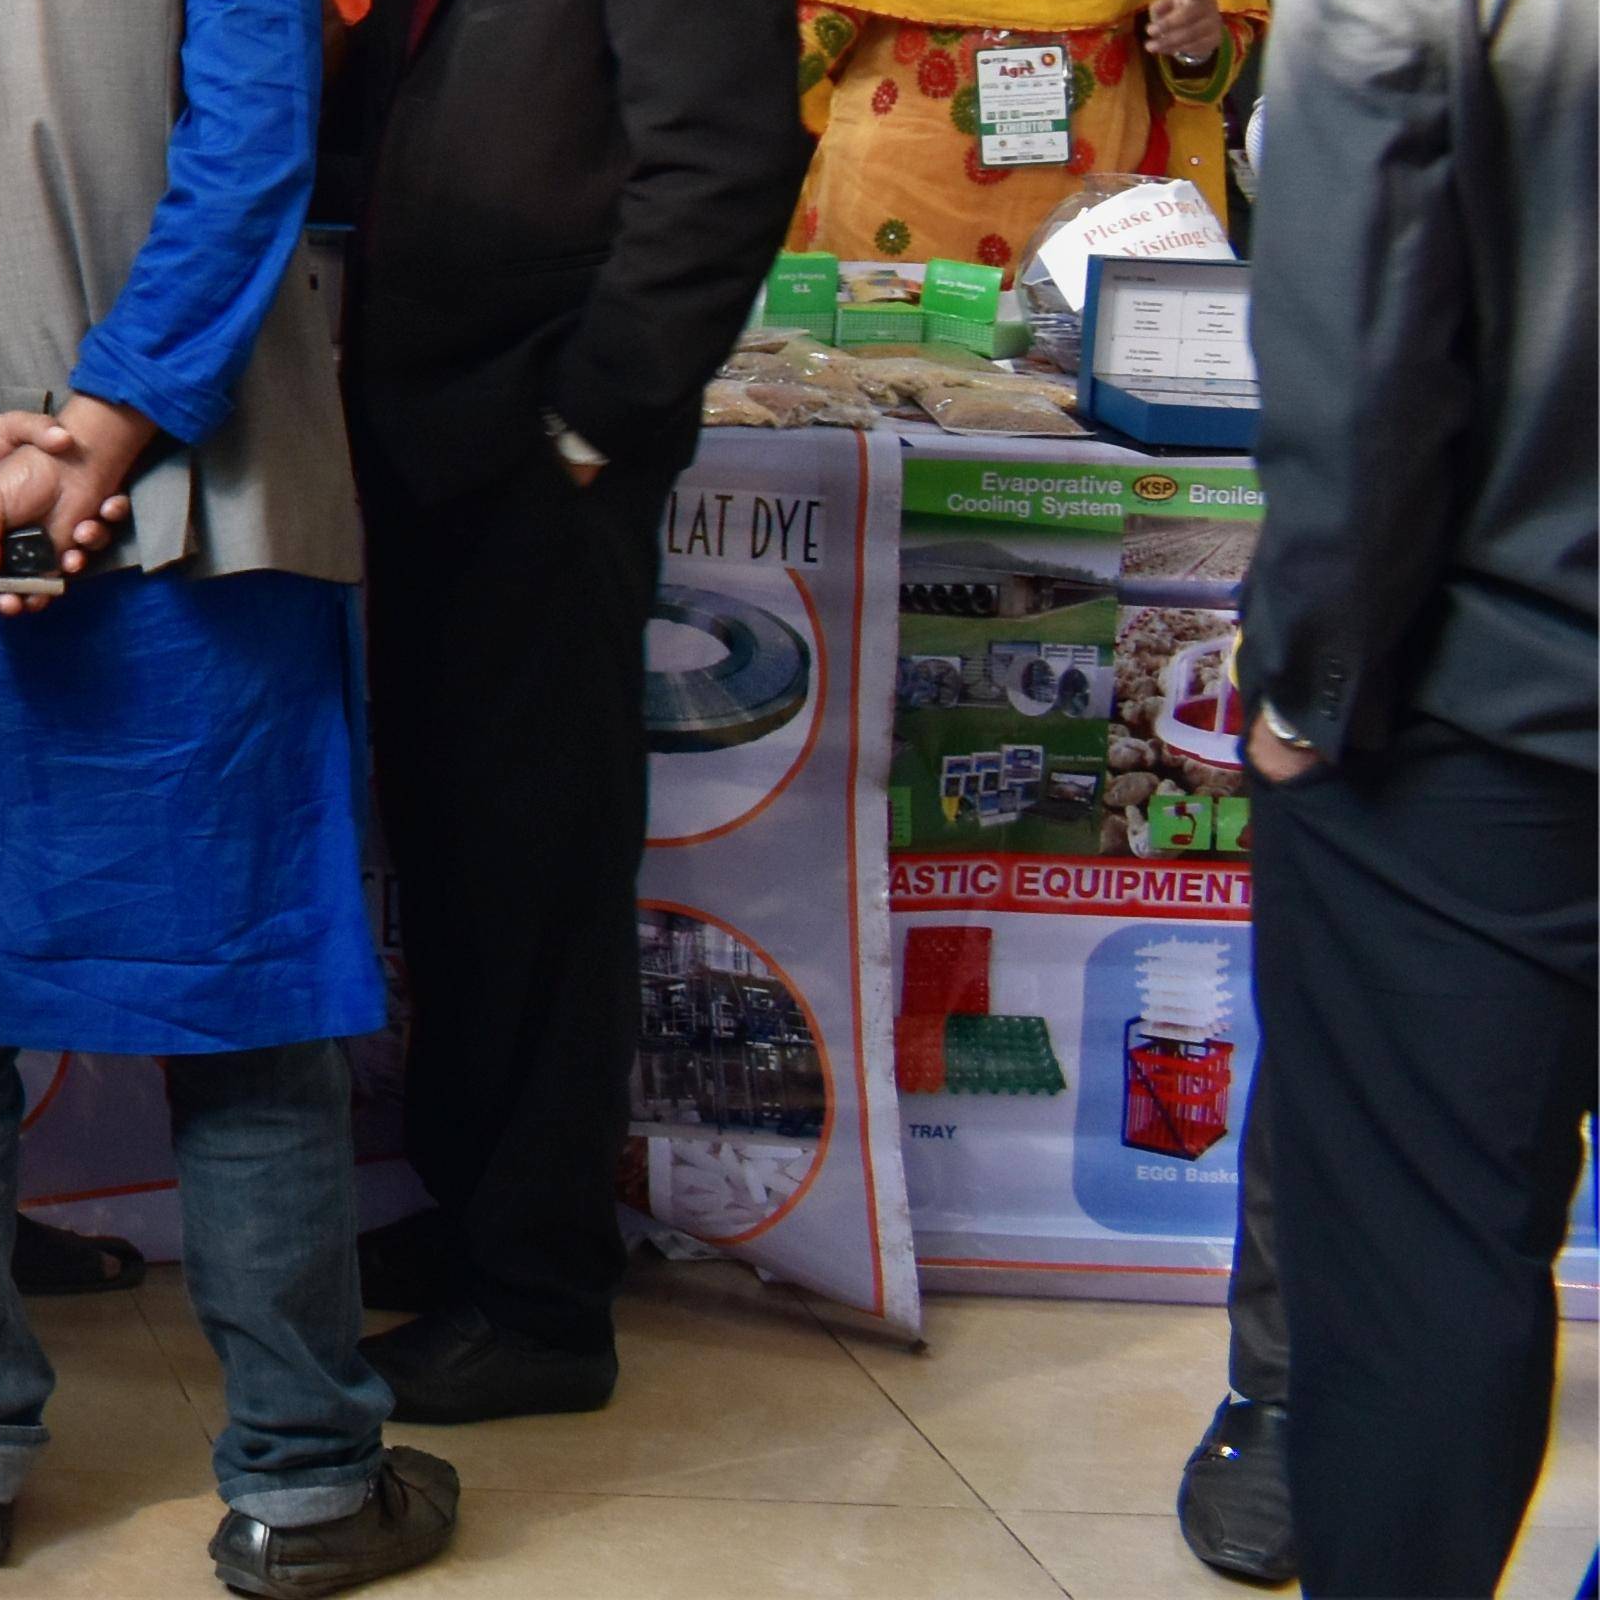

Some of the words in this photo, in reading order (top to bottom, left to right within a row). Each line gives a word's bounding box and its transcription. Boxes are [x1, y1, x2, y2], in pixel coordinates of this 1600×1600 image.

[1083, 210, 1152, 247] Please
[980, 472, 1124, 497] Evaporative
[1138, 478, 1174, 496] KSP
[946, 493, 1032, 519] Cooling
[1041, 496, 1124, 519] System
[750, 496, 822, 563] DYE
[908, 1123, 958, 1140] TRAY
[1134, 1165, 1178, 1182] EGG
